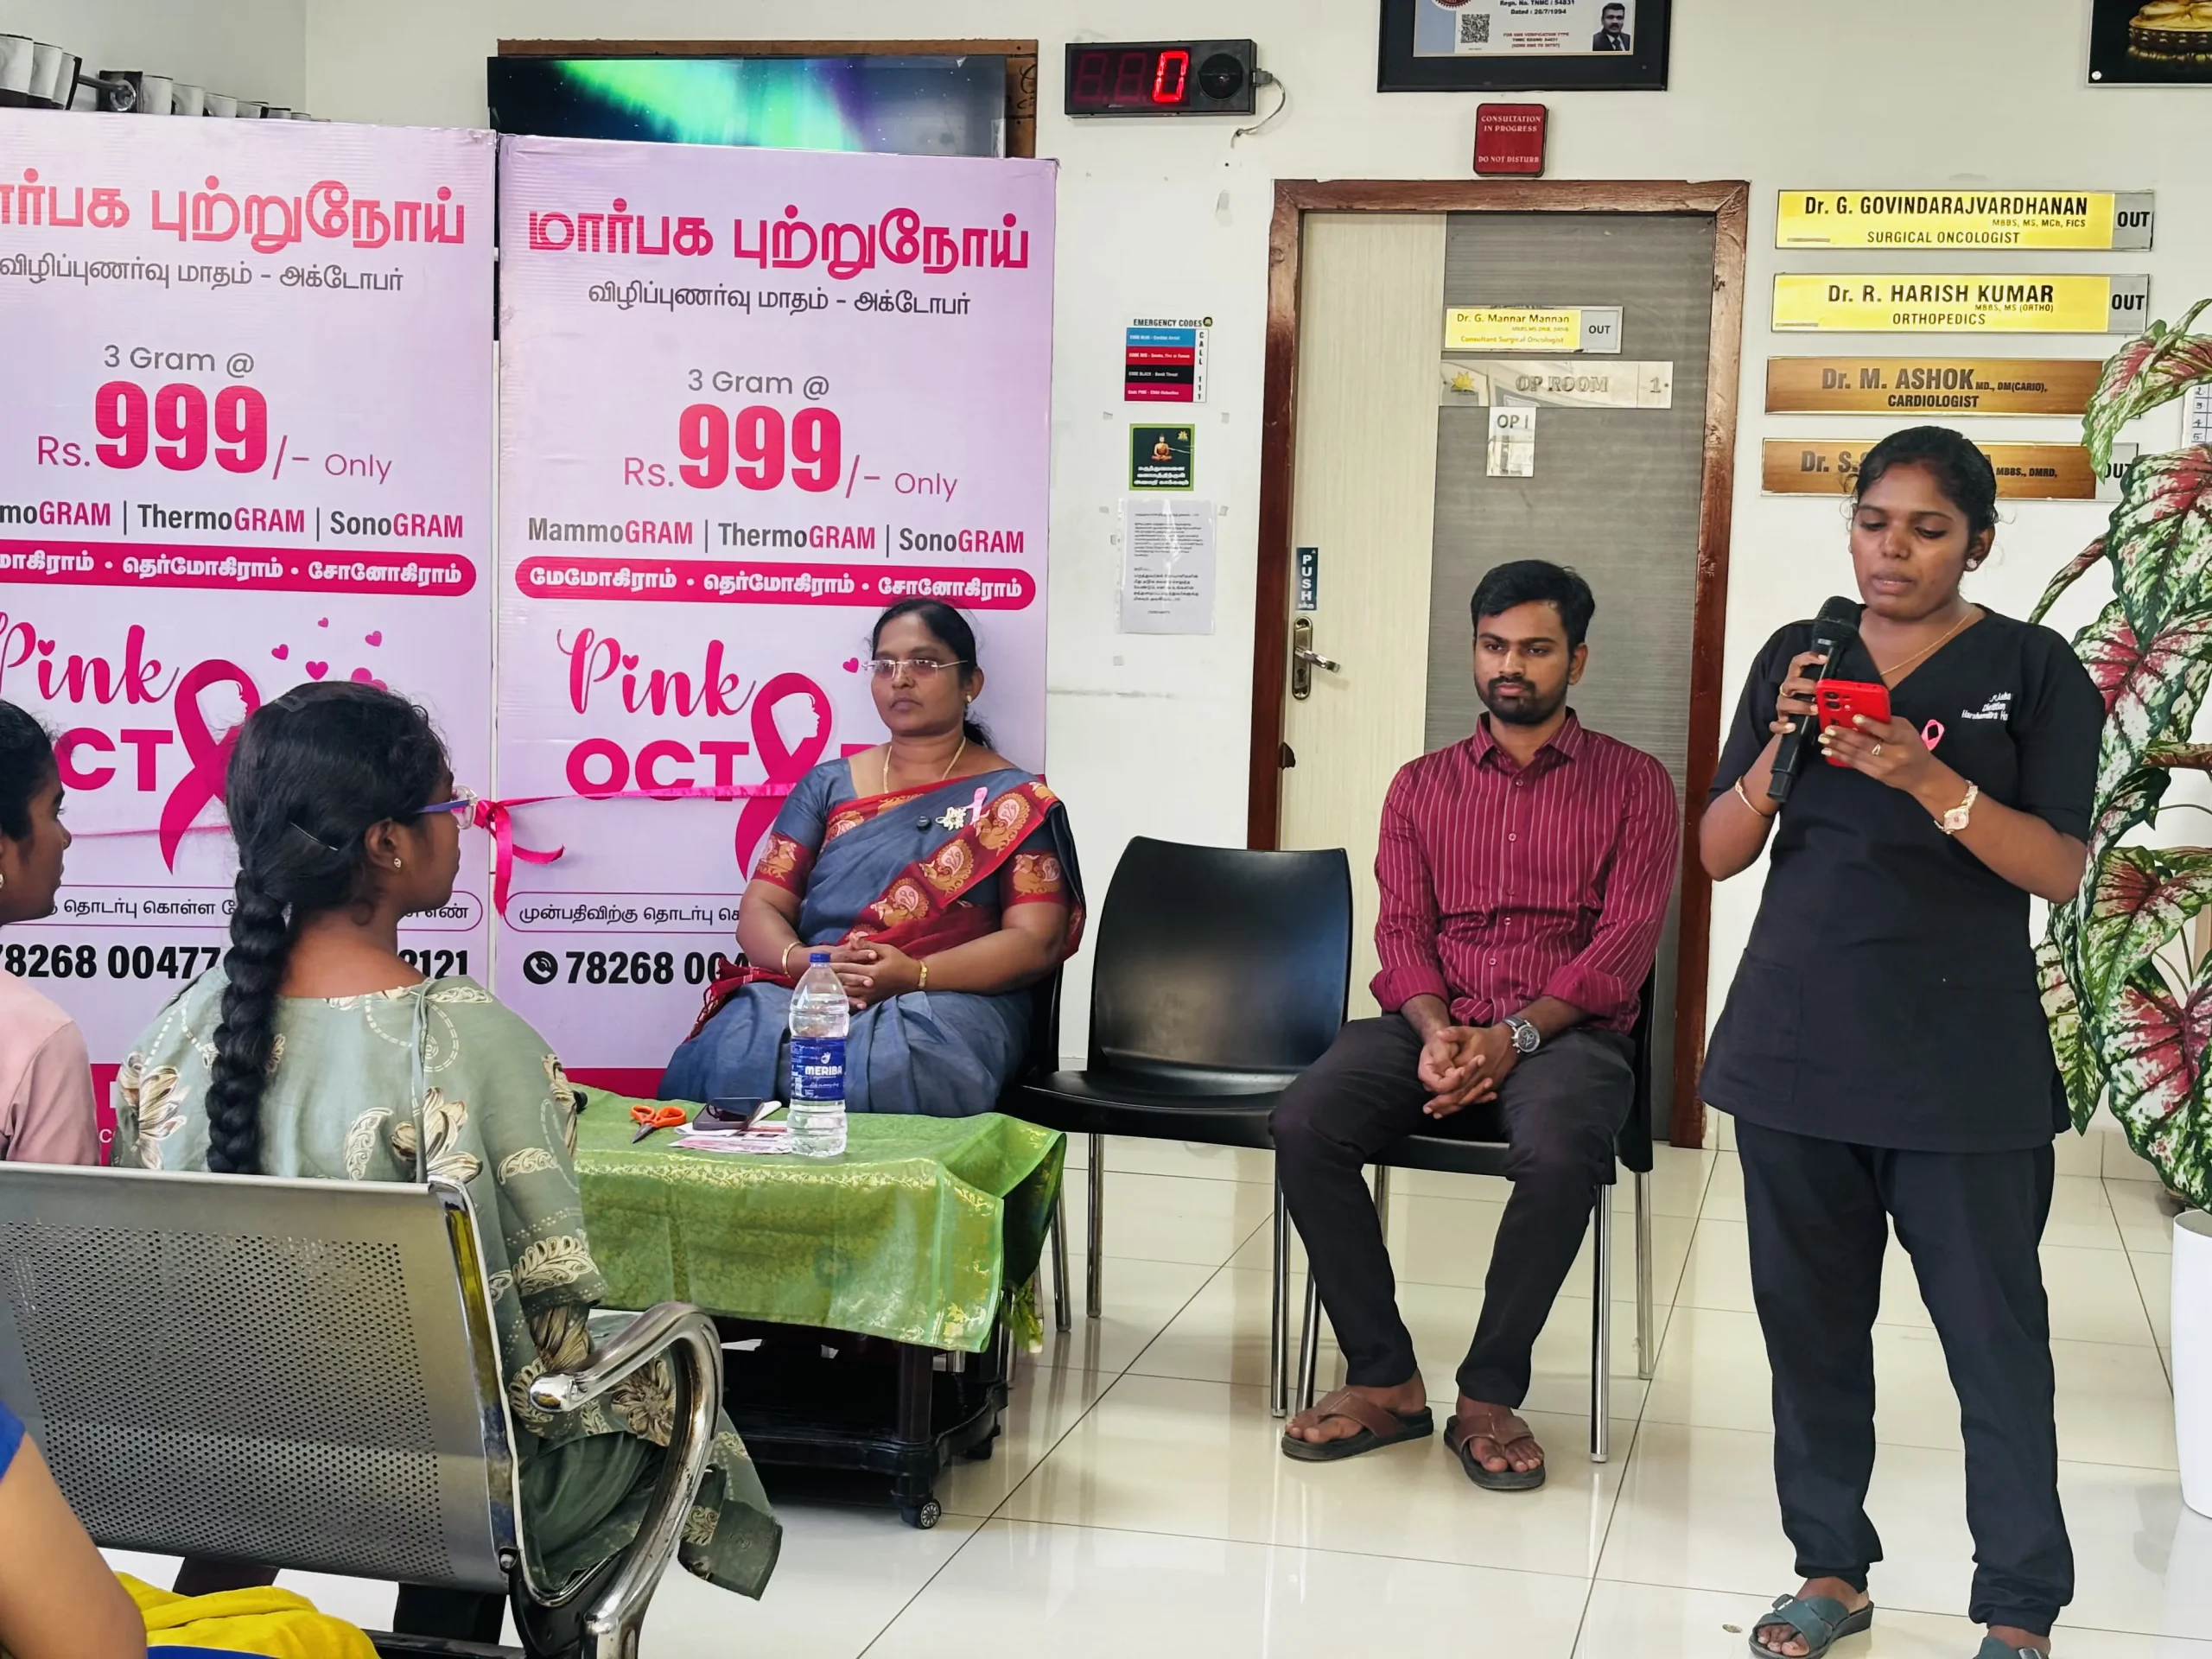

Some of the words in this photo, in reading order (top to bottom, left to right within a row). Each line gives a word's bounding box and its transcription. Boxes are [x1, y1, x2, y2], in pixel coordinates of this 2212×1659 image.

[151, 175, 464, 254] புற்றுநோய்
[1805, 196, 1829, 214] Dr.
[1836, 196, 1853, 214] G.
[1860, 196, 2088, 216] GOVINDARAJVARDHANAN
[1993, 219, 2020, 228] MBBS,
[2041, 219, 2063, 228] MCh,
[2117, 211, 2150, 227] OUT
[529, 198, 713, 256] மார்பக
[734, 204, 1029, 280] புற்றுநோய்
[1867, 232, 1932, 243] SURGICAL
[1937, 232, 2020, 244] ONCOLOGIST
[178, 260, 252, 289] மாதம்
[280, 264, 404, 291] அக்டோபர்
[588, 280, 750, 313] விழிப்புணர்வு
[759, 286, 828, 315] மாதம்
[854, 288, 970, 315] அக்டோபர்
[1828, 284, 1853, 302] Dr.
[1863, 284, 1882, 302] R.
[1891, 284, 1968, 302] HARISH
[1978, 284, 2054, 302] KUMAR
[2111, 294, 2145, 310] OUT
[1457, 314, 1471, 322] Dr.
[1488, 314, 1526, 323] Mannar
[1529, 315, 1569, 323] Mannan
[1892, 313, 1986, 325] ORTHOPEDICS
[2019, 304, 2054, 314] (ORTHO)
[1588, 325, 1611, 334] OUT
[1498, 336, 1526, 345] Surgical
[1528, 336, 1564, 345] Oncologist
[104, 345, 120, 367] 3
[130, 346, 215, 372] Gram
[226, 352, 255, 378] @
[688, 370, 702, 392] 3
[712, 372, 793, 395] Gram
[802, 375, 830, 400] @
[1516, 376, 1542, 391] OP
[1548, 376, 1608, 392] ROOM
[1822, 368, 1851, 389] Dr.
[1859, 368, 1887, 389] M.
[1895, 368, 1974, 390] ASHOK
[1887, 394, 1979, 408] CARDIOLOGIST
[1497, 414, 1519, 429] OP
[325, 454, 392, 484] Only
[1801, 451, 1829, 473] Dr.
[894, 473, 957, 502] Only
[0, 501, 111, 526] moGRAM
[137, 504, 305, 533] ThermoGRAM
[330, 510, 463, 538] SonoGRAM
[529, 518, 693, 544] MammoGRAM
[718, 522, 875, 550] ThermoGRAM
[899, 528, 1024, 553] SonoGRAM
[1300, 554, 1313, 601] PUSH
[557, 628, 756, 716] Pink
[64, 898, 137, 918] தொடர்பு
[143, 899, 216, 916] கொள்ள
[519, 904, 638, 925] முன்பதிவிற்கு
[644, 906, 713, 925] தொடர்பு
[0, 944, 97, 979] 8268
[566, 950, 674, 985] 78268
[804, 1065, 843, 1077] MERIBA
